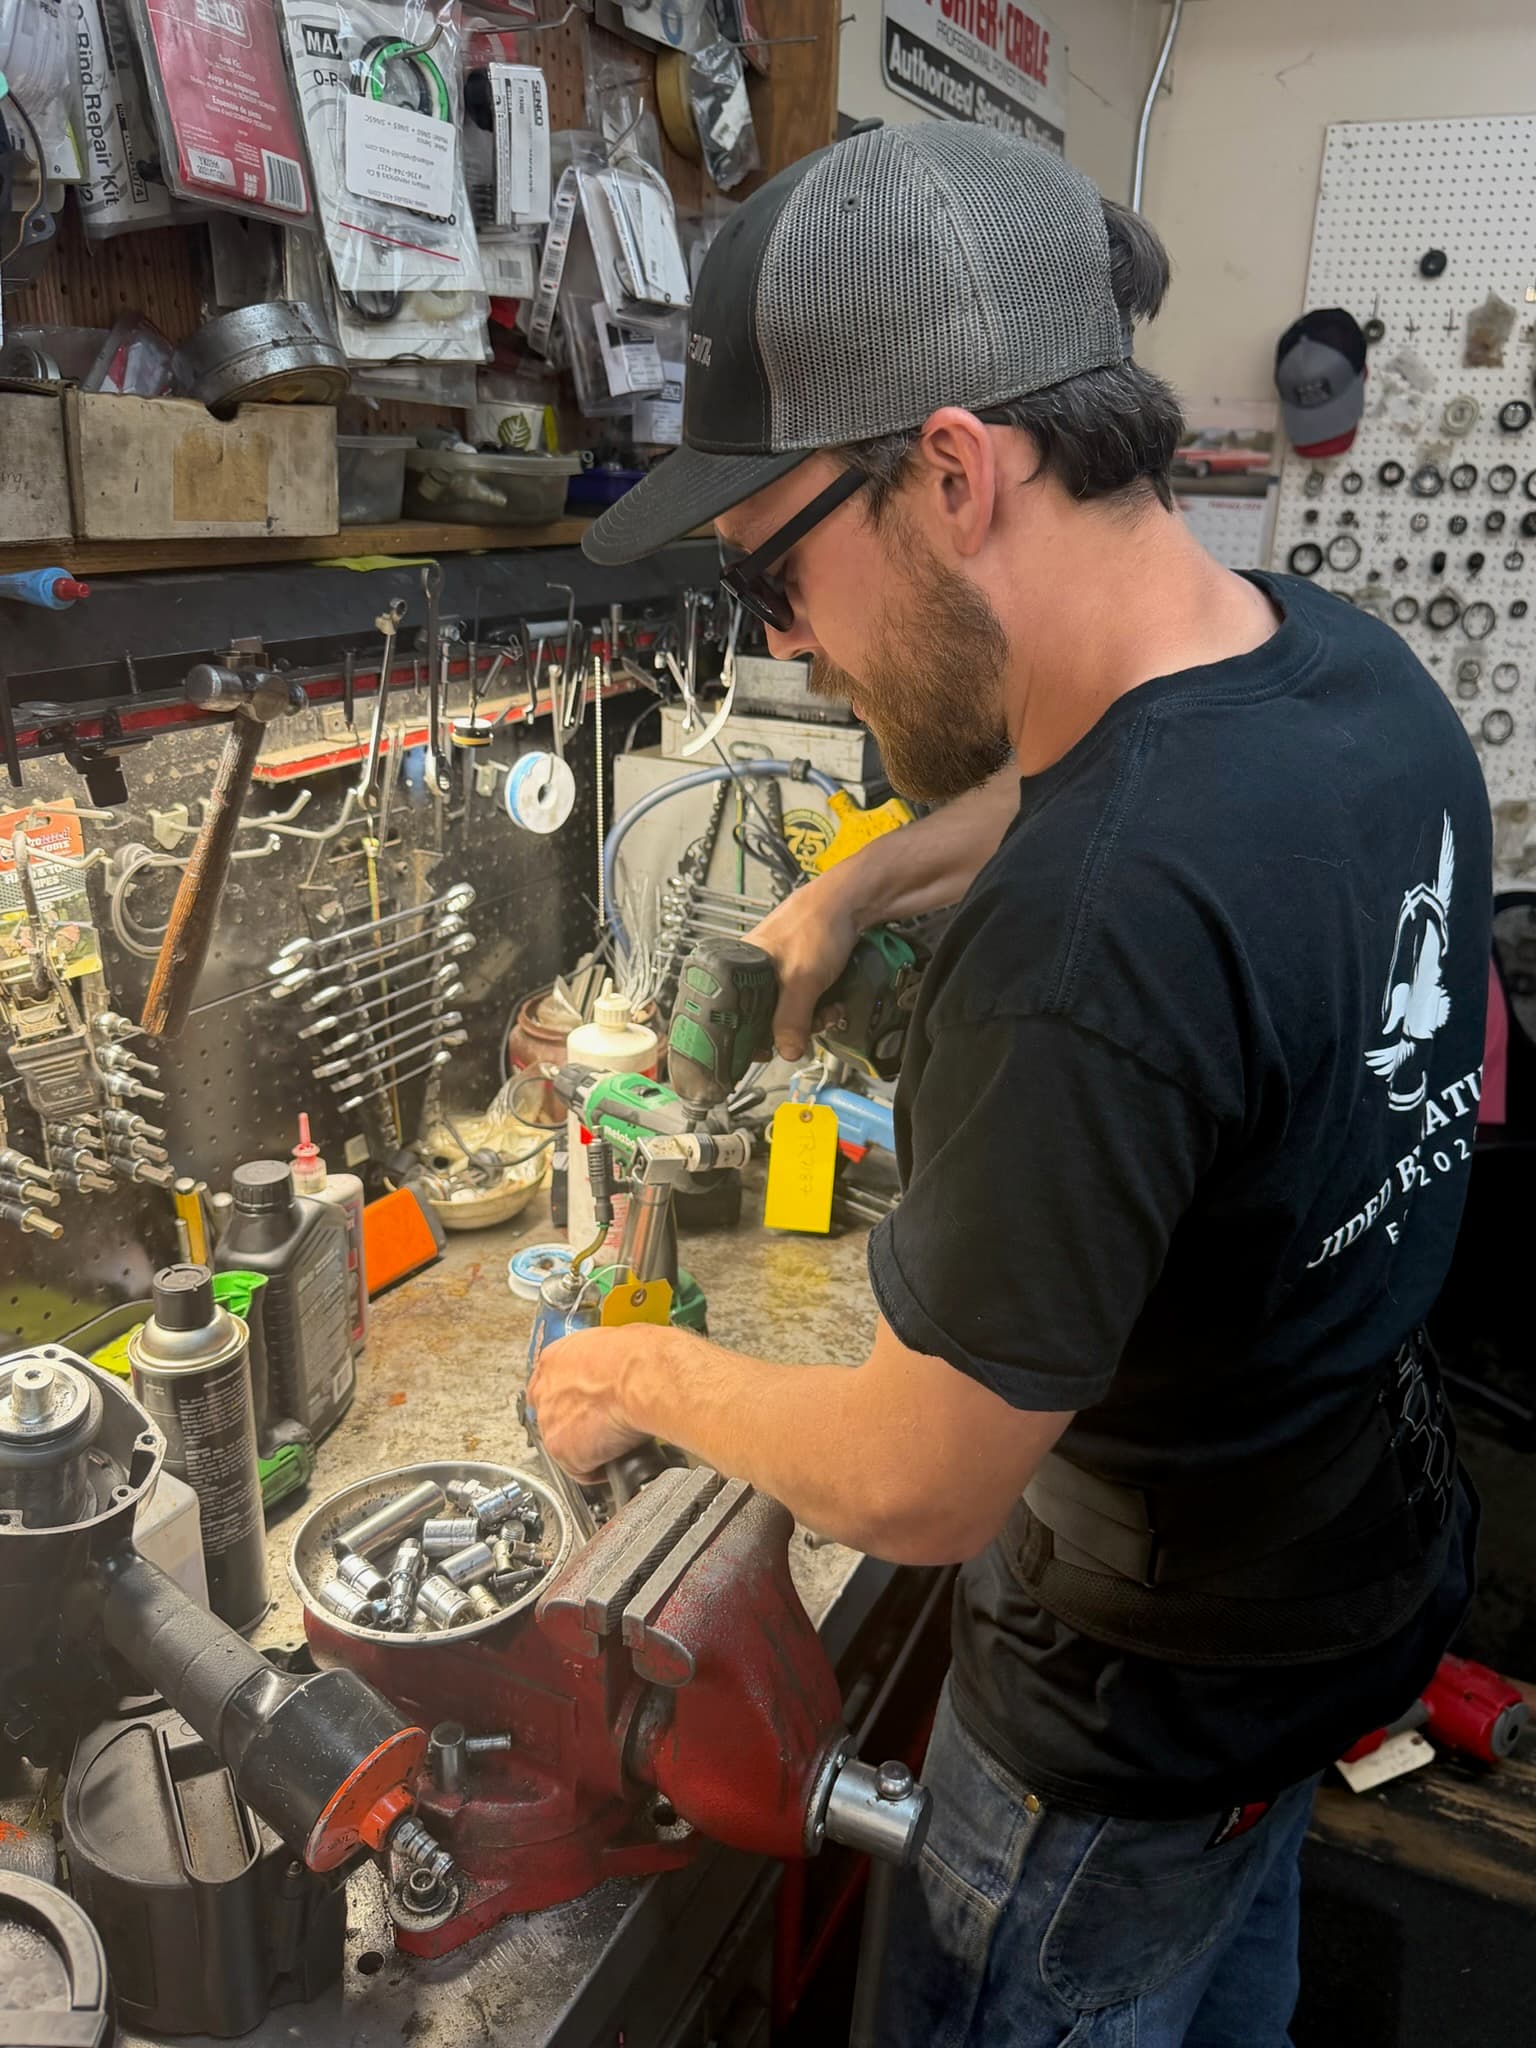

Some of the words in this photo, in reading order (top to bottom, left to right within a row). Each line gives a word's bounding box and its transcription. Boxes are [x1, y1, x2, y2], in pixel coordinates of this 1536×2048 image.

[533, 80, 544, 127] SENCO
[889, 32, 975, 117] Authorized
[974, 87, 1024, 138] Service
[84, 94, 112, 168] Repair
[100, 174, 119, 206] Kit
[603, 1125, 637, 1150] metabo
